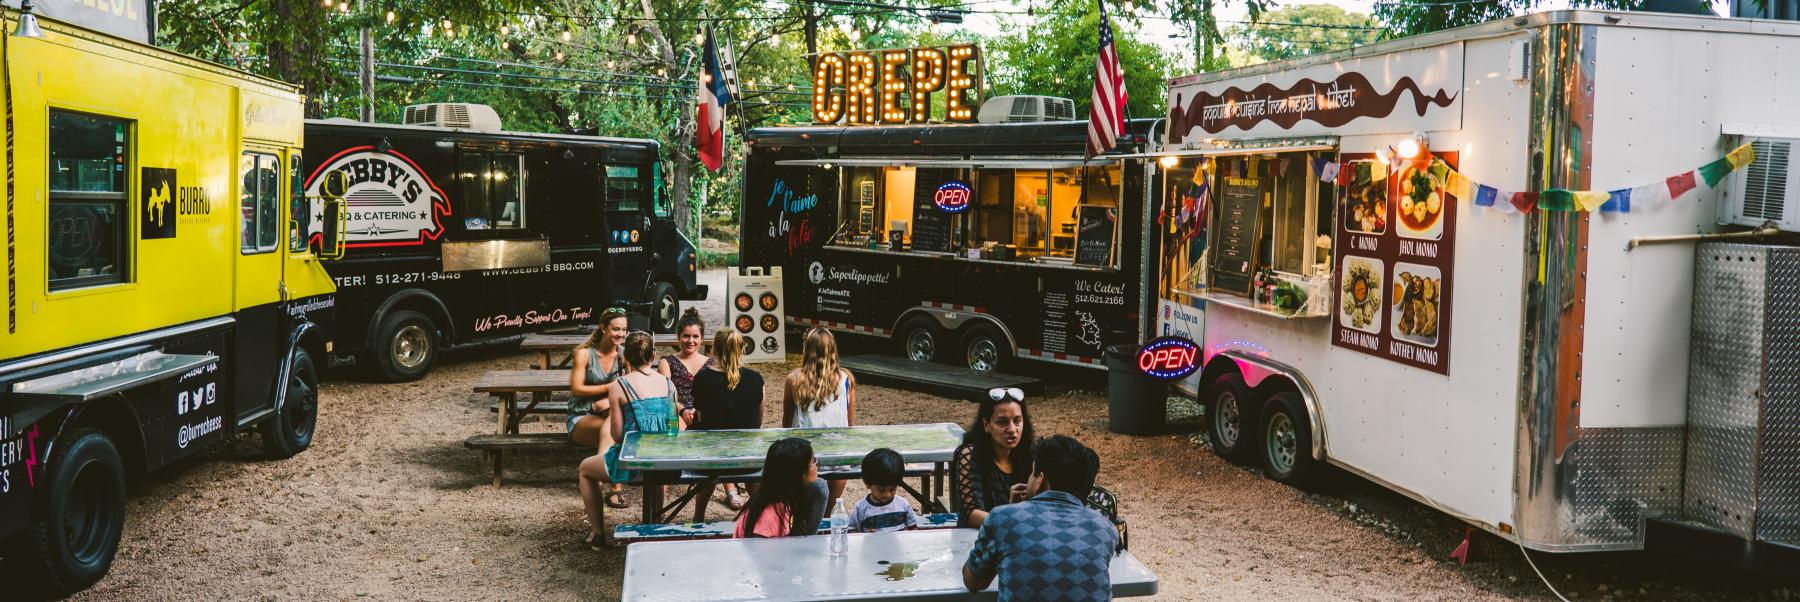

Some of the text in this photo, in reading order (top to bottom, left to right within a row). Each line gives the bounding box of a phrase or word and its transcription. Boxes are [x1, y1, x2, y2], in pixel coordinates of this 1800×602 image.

[811, 43, 979, 126] CREPE
[1235, 94, 1266, 120] cuisine
[1267, 95, 1288, 115] from
[1288, 83, 1317, 120] nepal
[1326, 80, 1357, 110] tibet
[180, 186, 210, 215] BURRO
[934, 189, 970, 205] OPEN
[364, 211, 417, 220] CATERING
[779, 210, 790, 236] la
[1358, 236, 1378, 251] MOMO
[1399, 240, 1438, 258] JHOL MOMO
[1074, 280, 1125, 294] We Cater!
[1075, 294, 1125, 305] 512.621.2166
[475, 307, 593, 331] We Proudly Support Our Troops!
[1340, 330, 1379, 350] STEAM MOMO
[1140, 347, 1197, 370] OPEN
[1390, 341, 1438, 366] KOTHEY MOMO
